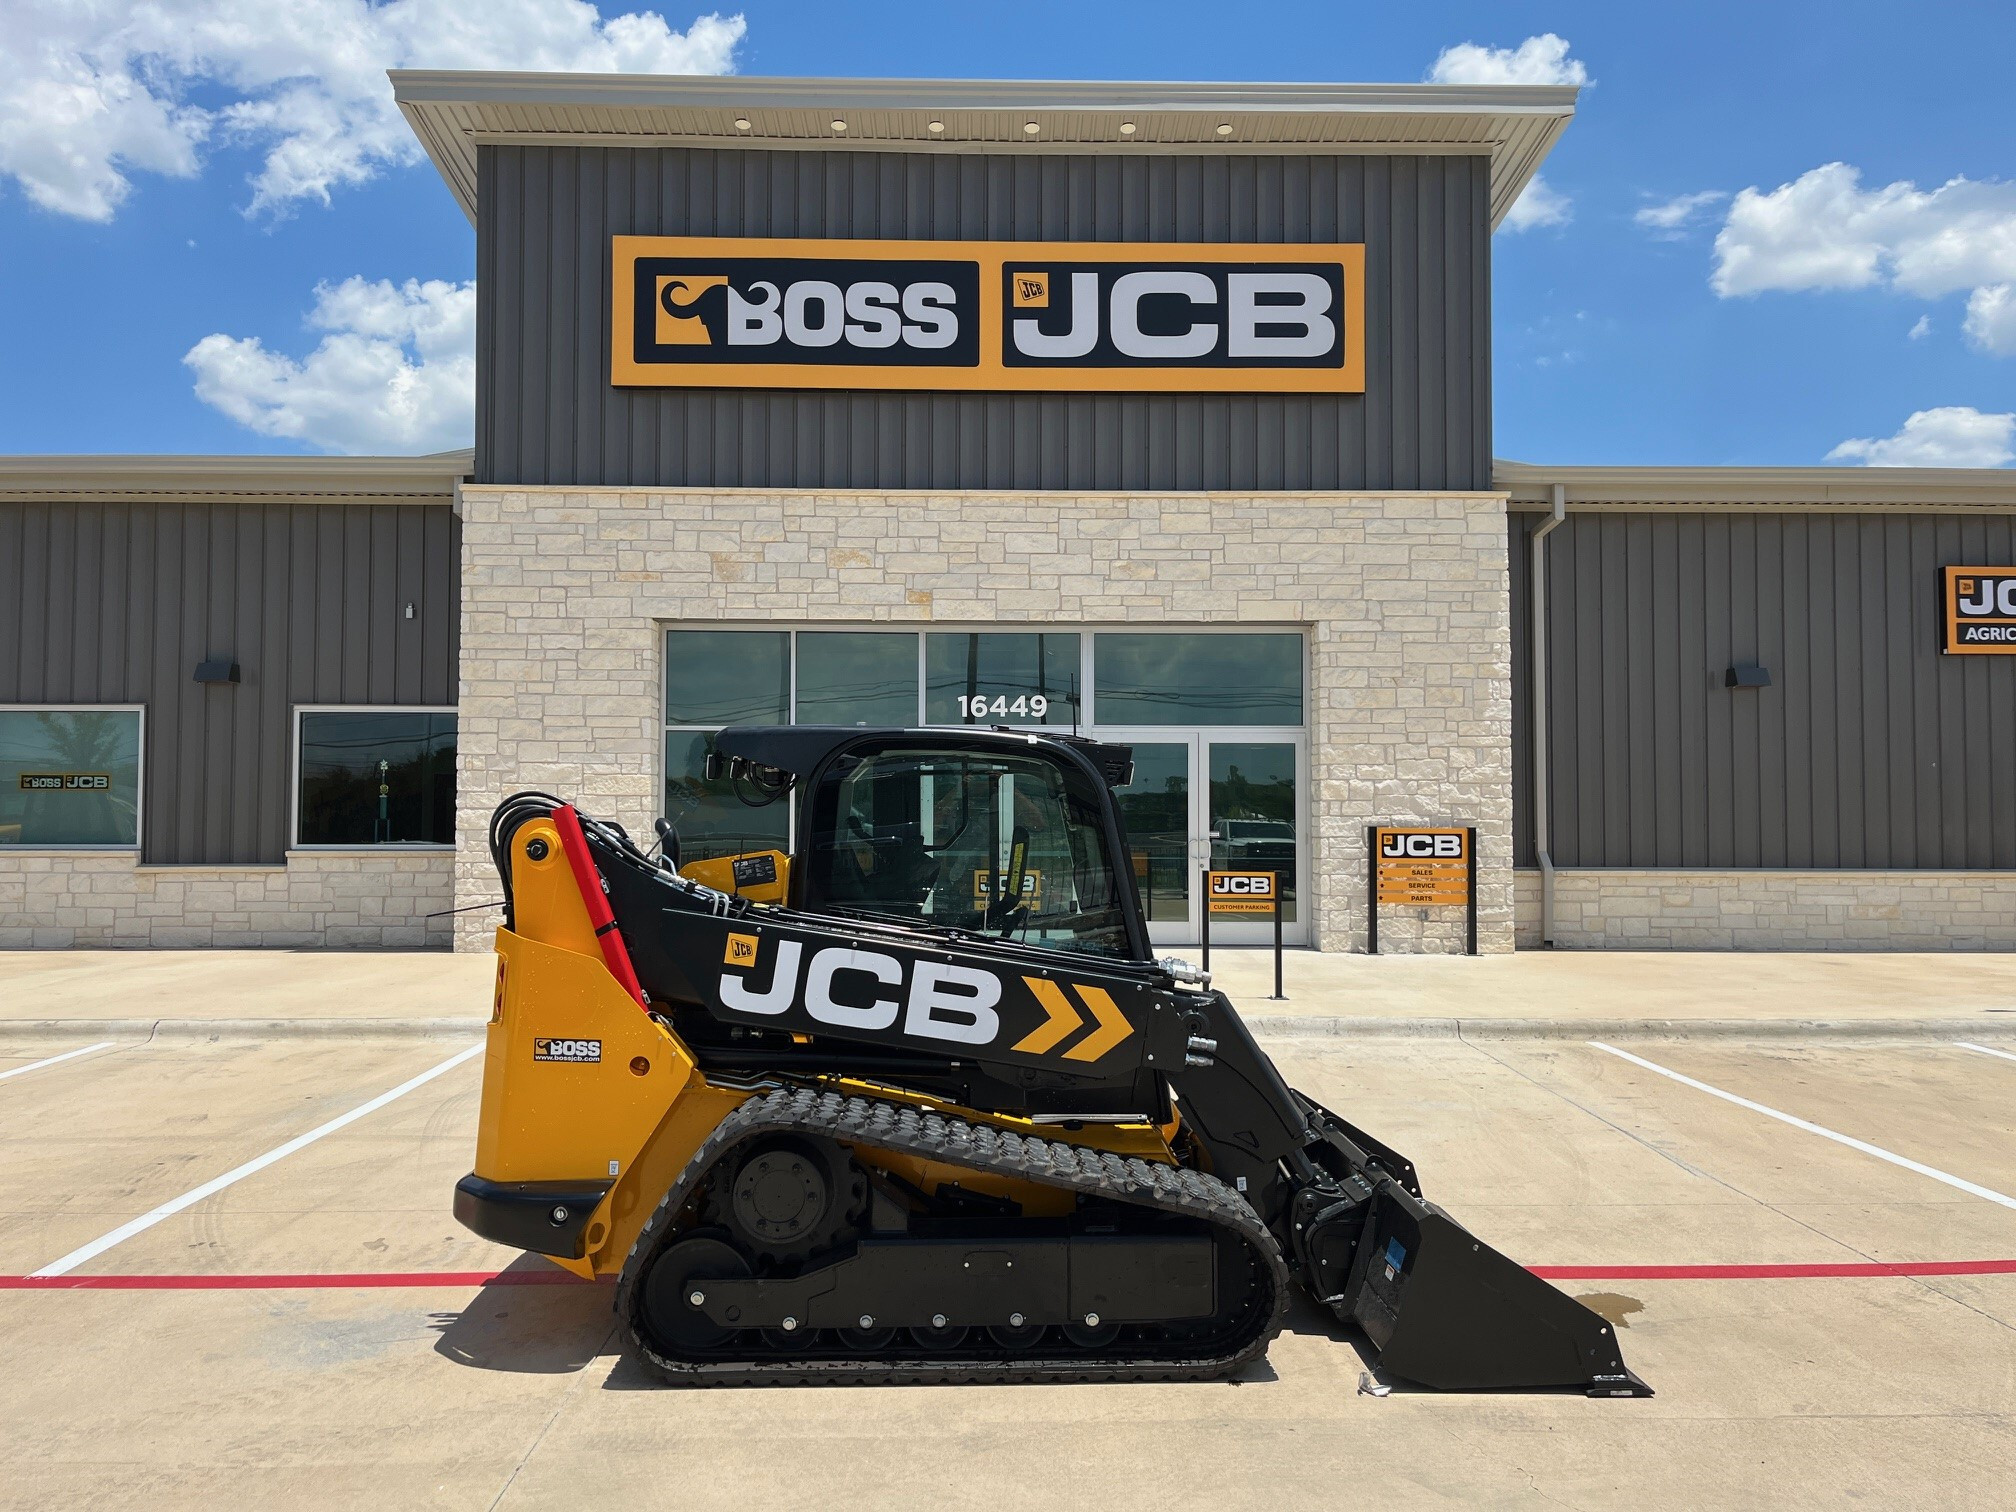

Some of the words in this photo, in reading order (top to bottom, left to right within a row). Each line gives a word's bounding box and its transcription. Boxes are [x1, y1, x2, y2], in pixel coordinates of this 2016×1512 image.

[1022, 281, 1042, 298] JCB
[727, 280, 958, 349] BOSS
[1013, 271, 1335, 358] JCB
[957, 694, 1047, 718] 16449
[32, 778, 61, 788] BOSS
[66, 776, 108, 788] JCB
[1383, 835, 1461, 856] JCB
[1213, 877, 1270, 893] JCB
[733, 941, 752, 957] JCB
[719, 940, 1002, 1045] JCB
[550, 1040, 601, 1057] BOSS
